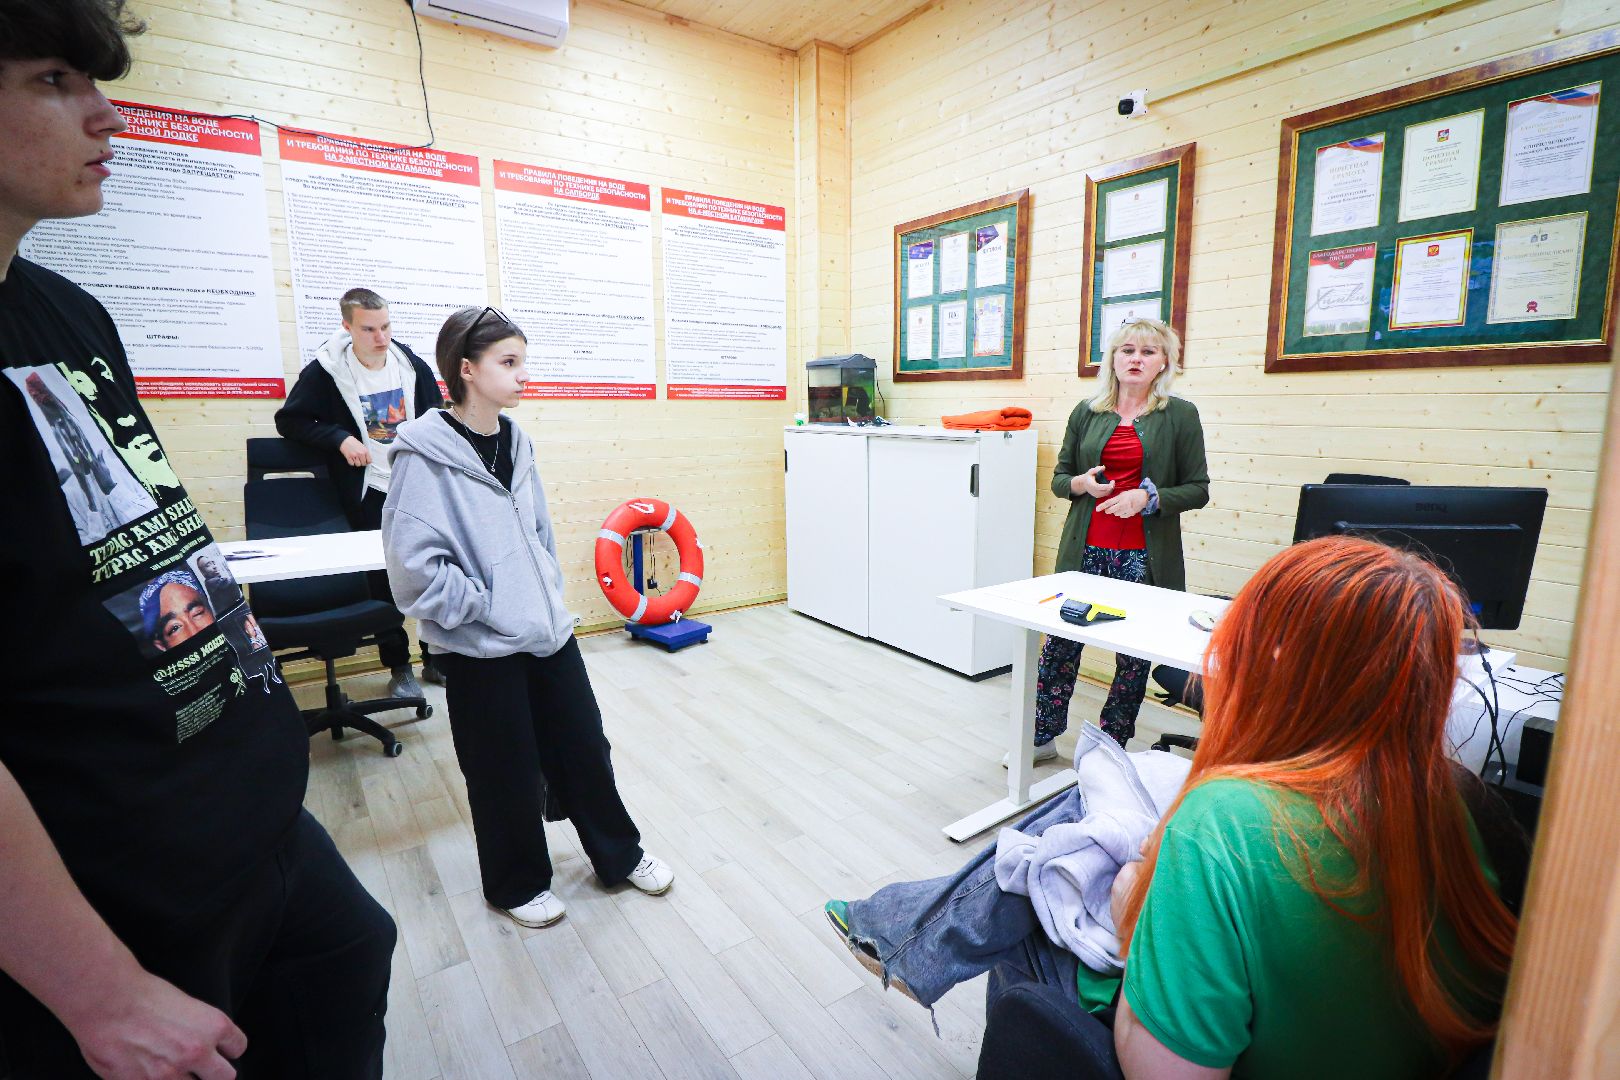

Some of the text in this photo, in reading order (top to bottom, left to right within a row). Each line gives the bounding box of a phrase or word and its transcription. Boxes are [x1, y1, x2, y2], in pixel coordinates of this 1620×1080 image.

[116, 106, 219, 128] ОВЕДЕНИЯ НА ВОДЕ
[126, 126, 199, 142] СТНОЙ ЛОДКЕ
[170, 122, 254, 140] БЕЗОПАСНОСТИ
[112, 155, 146, 164] тановкой
[127, 151, 176, 162] осторожность
[296, 141, 354, 156] ТРЕБОВАНИЯ
[356, 150, 369, 158] ПО
[370, 152, 408, 164] ТЕХНИКЕ
[409, 157, 473, 173] БЕЗОПАСНОСТИ
[316, 135, 446, 162] ПРАВИЛА ПОВЕДЕНИЯ НА ВОДЕ
[324, 152, 444, 178] НА 2-МЕСТНОМ КАТАМАРАНЕ
[508, 172, 552, 186] ТРЕБОВАНИЯ
[554, 180, 564, 188] ПО
[565, 182, 594, 192] ТЕХНИКЕ
[596, 186, 646, 200] БЕЗОПАСНОСТИ
[523, 168, 556, 179] ПРАВИЛА
[558, 173, 598, 186] ПОВЕДЕНИЯ
[608, 182, 626, 190] ВОДЕ
[564, 188, 600, 200] САПБОРДЕ
[684, 194, 711, 204] ПРАВИЛА
[712, 198, 744, 209] ПОВЕДЕНИЯ
[752, 205, 766, 213] ВОДЕ
[672, 198, 708, 209] ТРЕБОВАНИЯ
[718, 206, 742, 215] ТЕХНИКЕ
[742, 209, 782, 222] БЕЗОПАСНОСТИ
[731, 213, 764, 225] КАТАМАРАНЕ
[165, 498, 196, 522] SHA
[92, 548, 149, 584] TUPAC
[176, 513, 205, 537] SHA
